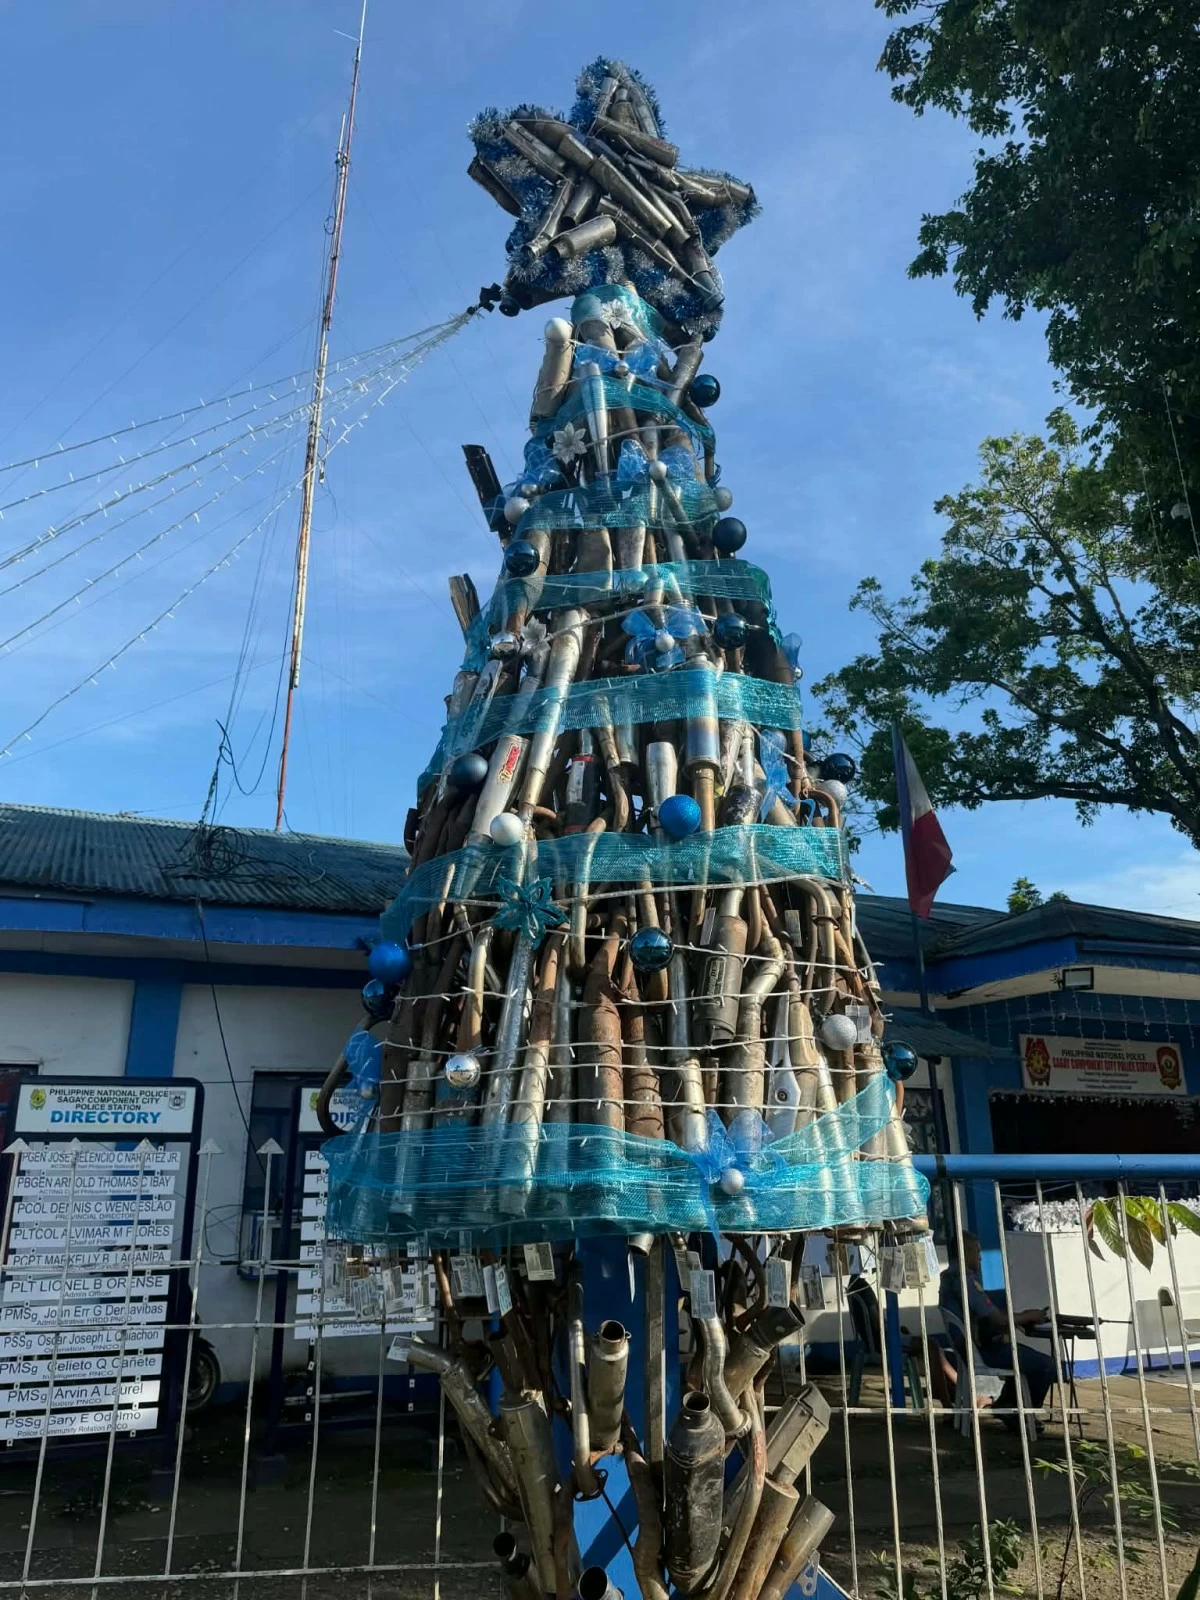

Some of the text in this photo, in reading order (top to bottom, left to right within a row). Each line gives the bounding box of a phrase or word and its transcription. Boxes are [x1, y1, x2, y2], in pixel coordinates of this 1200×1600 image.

[49, 1088, 169, 1098] PHILIPPINE NATIONAL POLICE
[87, 1096, 140, 1104] COMPONENT
[141, 1097, 161, 1105] CITY
[107, 1103, 142, 1111] STATION
[50, 1110, 162, 1124] DIRECTORY
[116, 1152, 123, 1163] C
[124, 1152, 166, 1163] NARATEZ
[17, 1177, 53, 1188] PBGEN
[98, 1176, 138, 1187] THOMAS
[149, 1176, 171, 1187] IBAY
[17, 1203, 47, 1214] PCOL
[94, 1202, 102, 1213] C
[105, 1201, 172, 1212] WENCESLAO
[14, 1228, 59, 1240] PLTCOL
[60, 1227, 110, 1239] ALVIMAR
[113, 1227, 123, 1238] M
[11, 1276, 163, 1293] PLT LIONEL B ORENSE
[4, 1308, 38, 1322] PMSg
[73, 1305, 91, 1317] Err
[93, 1305, 102, 1316] G
[36, 1318, 85, 1326] Adminstrative
[3, 1335, 32, 1350] PSSg
[37, 1333, 66, 1346] Oscar
[69, 1332, 104, 1346] Joseph
[106, 1331, 112, 1342] L
[0, 1362, 38, 1375] PMSg
[96, 1358, 107, 1370] Q
[111, 1356, 156, 1369] Cañete
[42, 1371, 87, 1379] Inelligence
[7, 1383, 144, 1403] PMSg Arvin A Laurel
[5, 1417, 42, 1429] PSSg
[47, 1414, 76, 1427] Gary
[80, 1413, 90, 1423] E
[39, 1427, 77, 1435] Cmmunity
